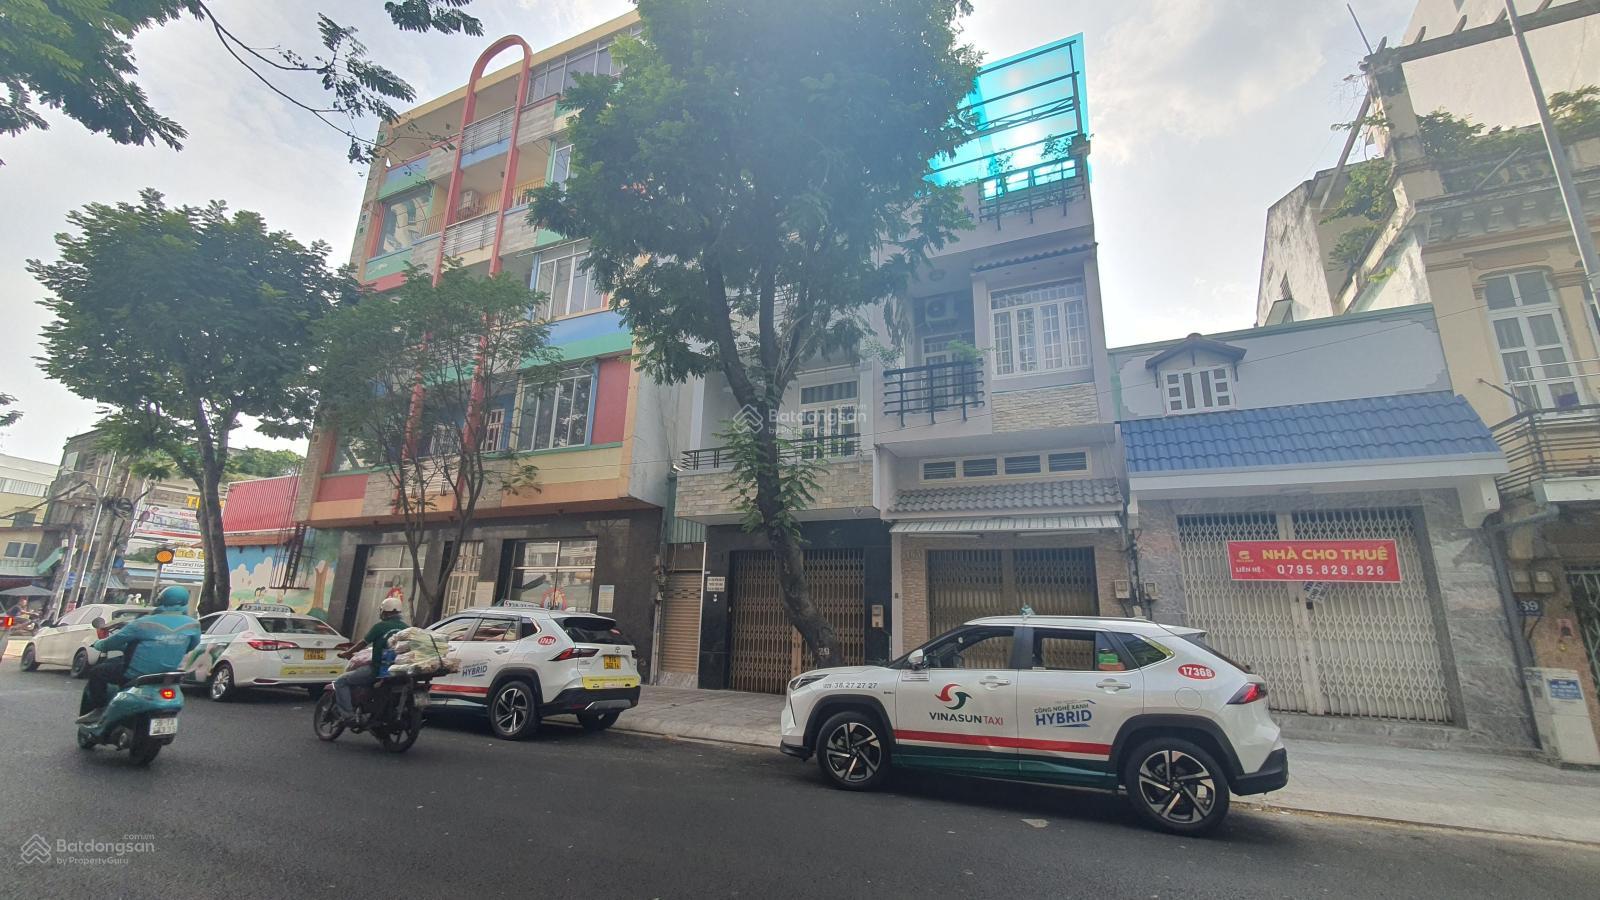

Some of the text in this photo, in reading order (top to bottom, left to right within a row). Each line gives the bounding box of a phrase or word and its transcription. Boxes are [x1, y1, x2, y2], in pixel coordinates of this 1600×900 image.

[1262, 546, 1388, 561] NHÀ CHO THUÊ
[1276, 564, 1384, 576] 0795.829.828
[462, 665, 488, 678] HYBRID
[1181, 666, 1213, 677] 17368
[929, 712, 1004, 726] VINASUN TAXI
[1035, 709, 1092, 726] HYBRID
